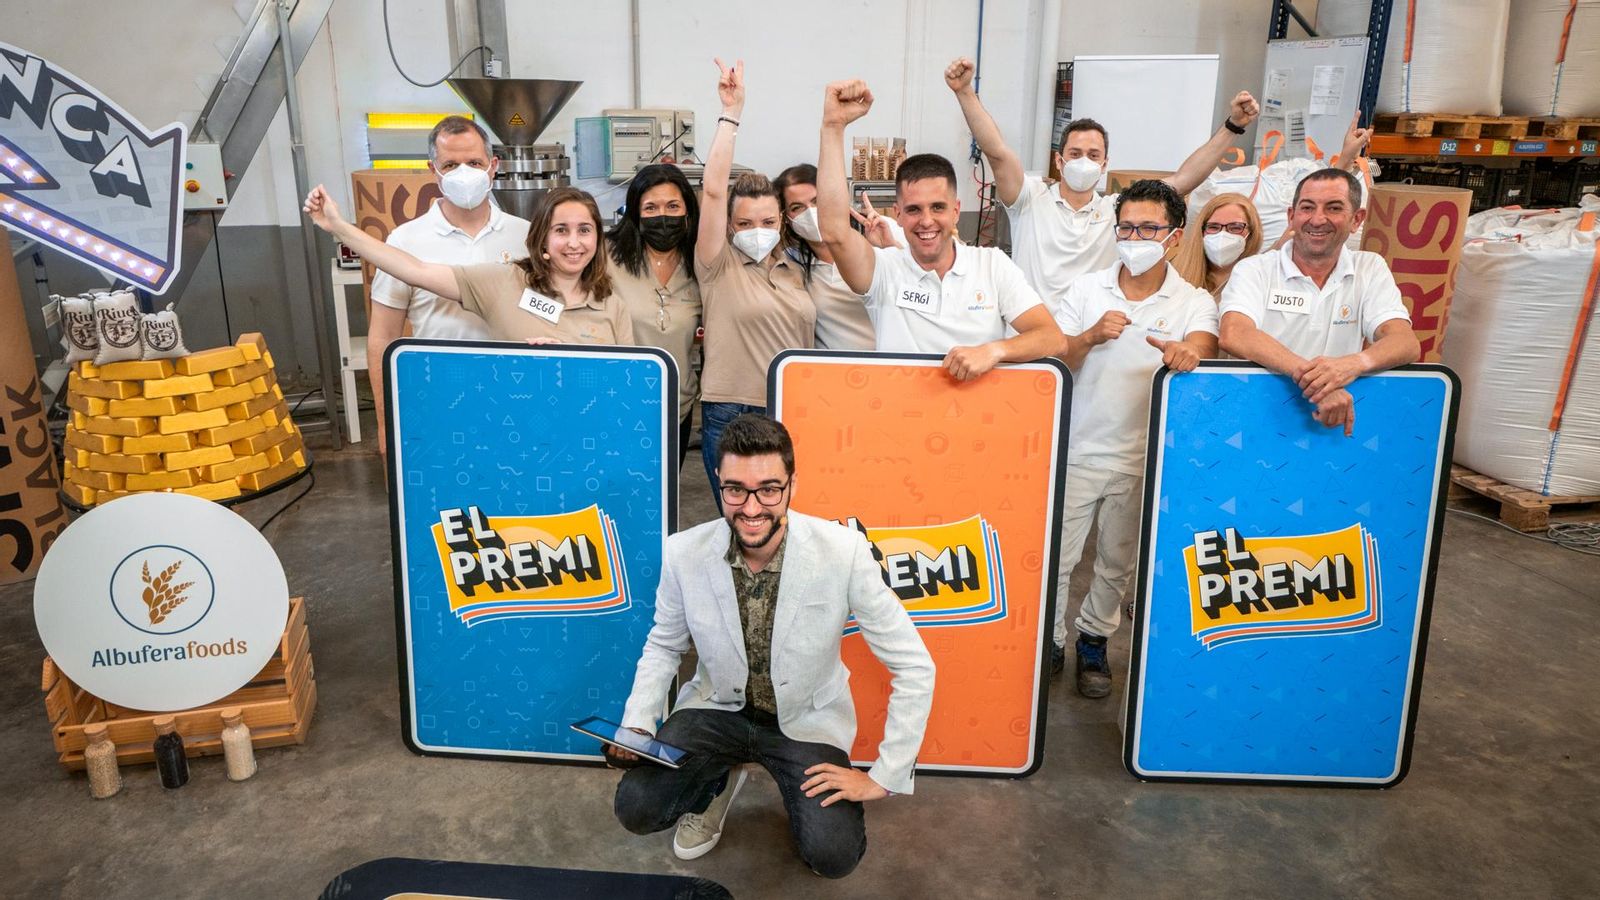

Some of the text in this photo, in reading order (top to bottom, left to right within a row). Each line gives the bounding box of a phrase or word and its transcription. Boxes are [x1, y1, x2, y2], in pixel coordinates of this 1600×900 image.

[529, 297, 556, 315] BEGO
[1273, 294, 1304, 307] JUSTO
[439, 505, 506, 551] EL
[1194, 527, 1259, 573] EL
[449, 534, 602, 597] PREMI
[882, 544, 980, 600] EMI
[1198, 553, 1356, 619] PREMI
[92, 637, 248, 668] Albuferafoods
